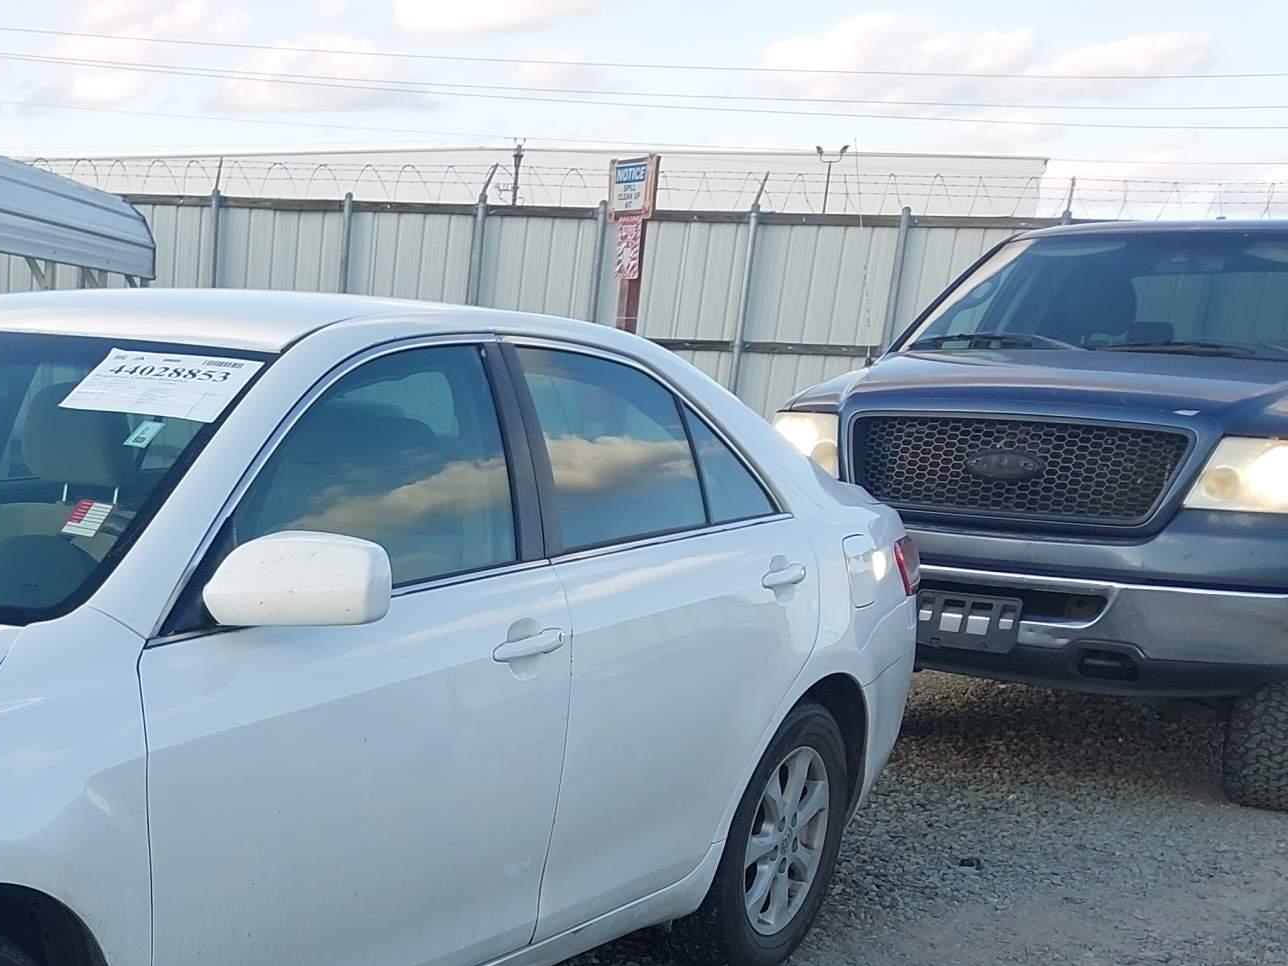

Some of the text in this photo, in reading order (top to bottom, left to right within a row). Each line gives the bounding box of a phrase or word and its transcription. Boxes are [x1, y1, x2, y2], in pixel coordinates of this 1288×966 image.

[617, 167, 646, 182] NOTICE
[618, 192, 641, 201] CLEAN UP
[109, 365, 230, 382] 44028853
